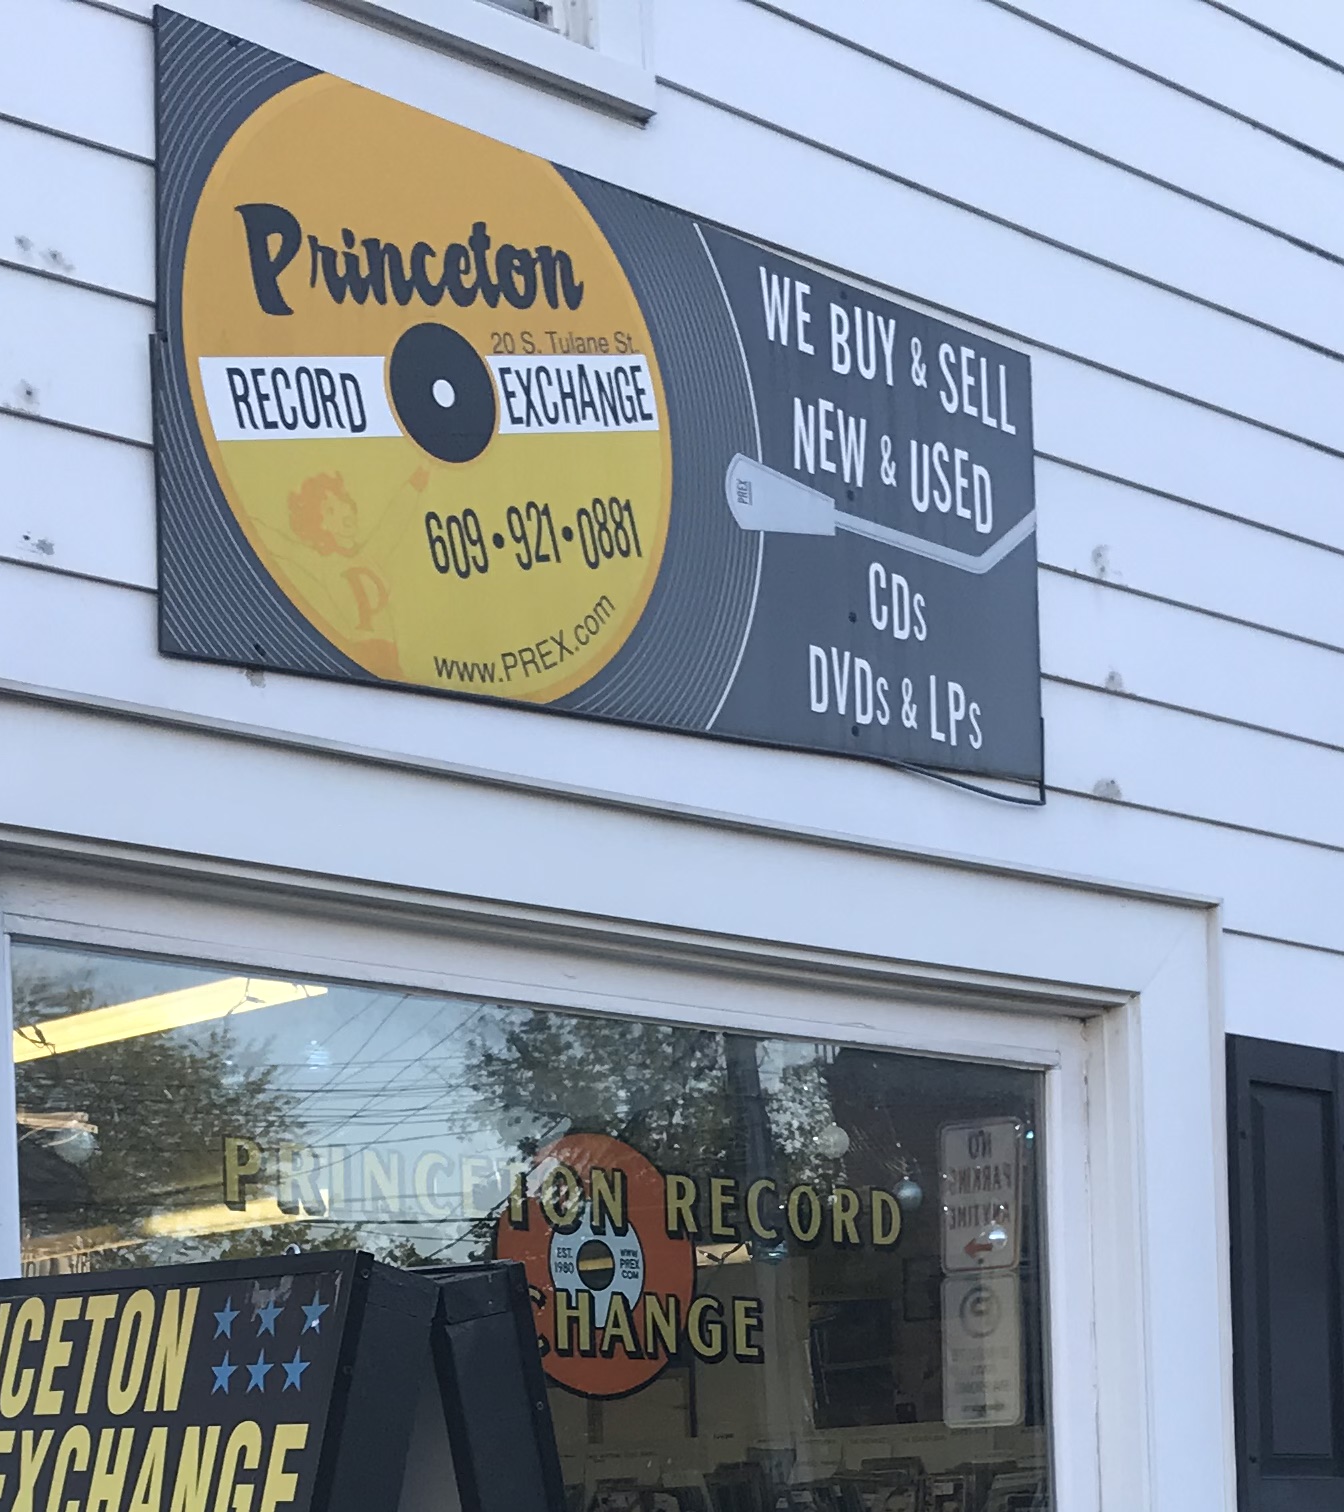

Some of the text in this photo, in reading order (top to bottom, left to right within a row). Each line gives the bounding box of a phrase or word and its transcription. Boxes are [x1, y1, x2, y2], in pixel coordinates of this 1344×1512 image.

[235, 203, 583, 316] Princeton
[491, 330, 640, 354] 20 S. Tulane St.
[759, 266, 1016, 437] WE BUY & SELL
[227, 367, 367, 433] RECORD
[498, 363, 653, 427] EXCHANGE
[737, 479, 751, 505] PREX
[792, 396, 993, 535] NEW & USED
[433, 593, 617, 684] www.PREX.com
[867, 562, 927, 643] CDs
[808, 645, 984, 750] DVDs & LPs
[223, 1135, 904, 1254] PRINCETON RECORD
[555, 1261, 575, 1274] 1980
[528, 1285, 765, 1364] HANGE
